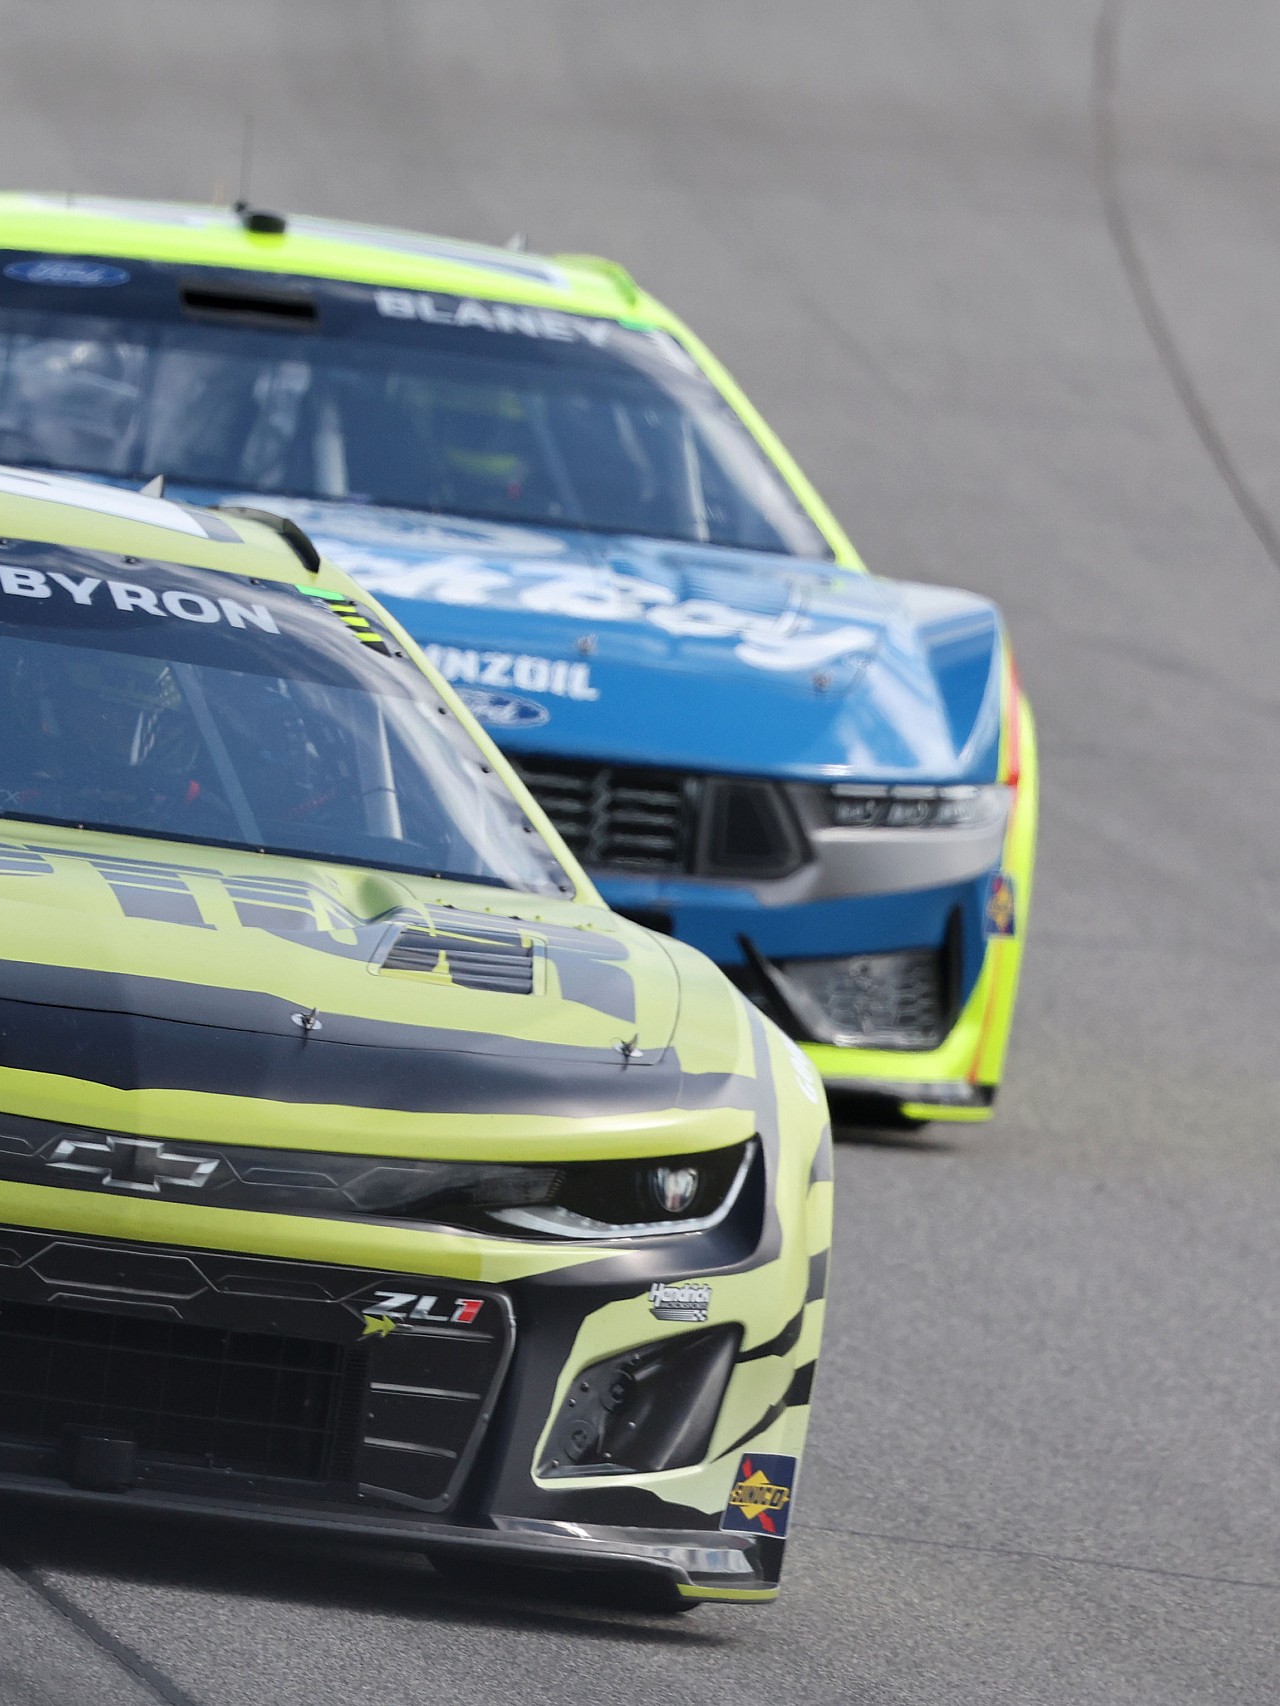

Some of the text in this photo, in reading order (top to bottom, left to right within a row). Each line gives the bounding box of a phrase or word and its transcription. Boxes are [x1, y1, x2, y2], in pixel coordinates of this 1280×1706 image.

[374, 289, 609, 348] BLANEY
[361, 1290, 485, 1324] ZL1
[732, 1485, 786, 1507] SUNOCO
